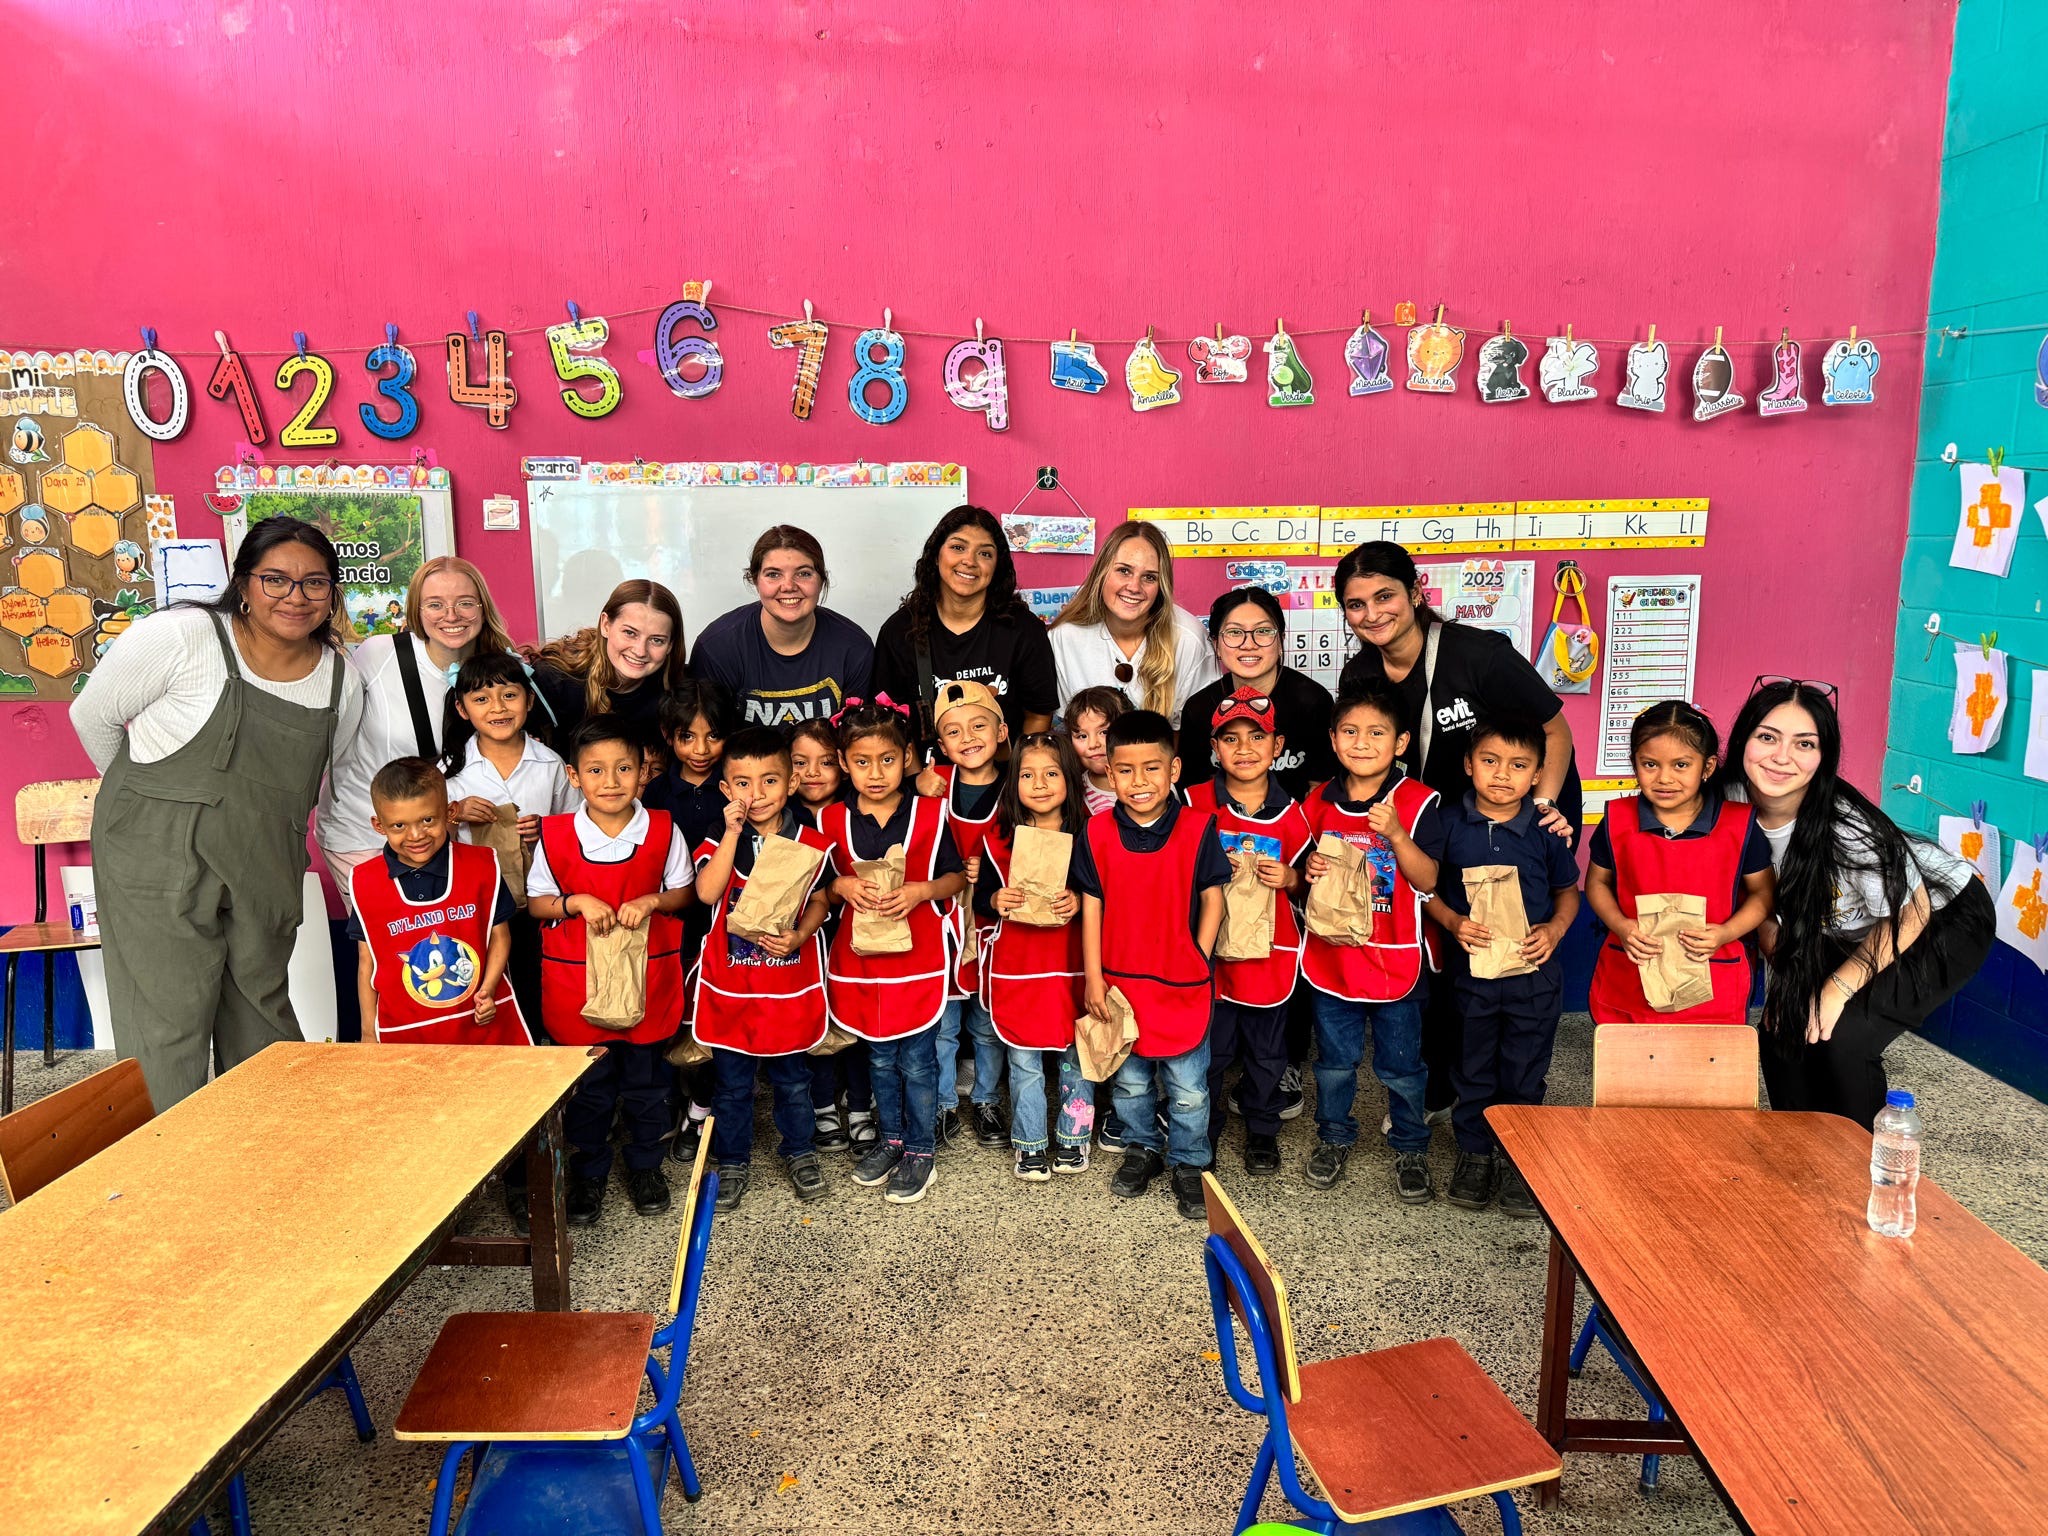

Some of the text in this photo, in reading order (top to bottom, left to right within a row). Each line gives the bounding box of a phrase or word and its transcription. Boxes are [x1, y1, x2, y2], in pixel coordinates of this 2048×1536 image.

[123, 349, 188, 441] 0
[207, 351, 268, 445] 1
[275, 352, 339, 447] 2
[359, 345, 418, 439] 3
[446, 330, 516, 428] 4
[546, 317, 622, 420] 5
[655, 300, 723, 399] 6
[768, 320, 828, 421] 7
[849, 328, 908, 424] 8
[1065, 377, 1085, 388] Azul
[1137, 391, 1175, 405] Amarillo
[1280, 391, 1306, 402] Verde
[1557, 387, 1590, 397] Blanco
[1634, 394, 1651, 405] Gris
[1187, 520, 1307, 543] Bb Cc Dd
[1332, 518, 1501, 543] Ee Ff Gg Hh
[1528, 513, 1694, 539] Ii Jj Kk Ll
[331, 541, 380, 557] mos
[337, 563, 389, 582] encia
[1463, 571, 1504, 586] 2025
[1322, 595, 1332, 606] M
[1455, 604, 1494, 619] MAYO
[60, 636, 70, 647] 23
[1296, 634, 1307, 649] 5
[1319, 634, 1330, 648] 6
[1294, 654, 1308, 668] 12
[1318, 653, 1331, 668] 13
[955, 666, 994, 680] DENTAL
[744, 697, 832, 727] NAU
[1436, 697, 1475, 725] evit
[387, 903, 477, 936] DYLAND CAP
[726, 953, 761, 968] Justin
